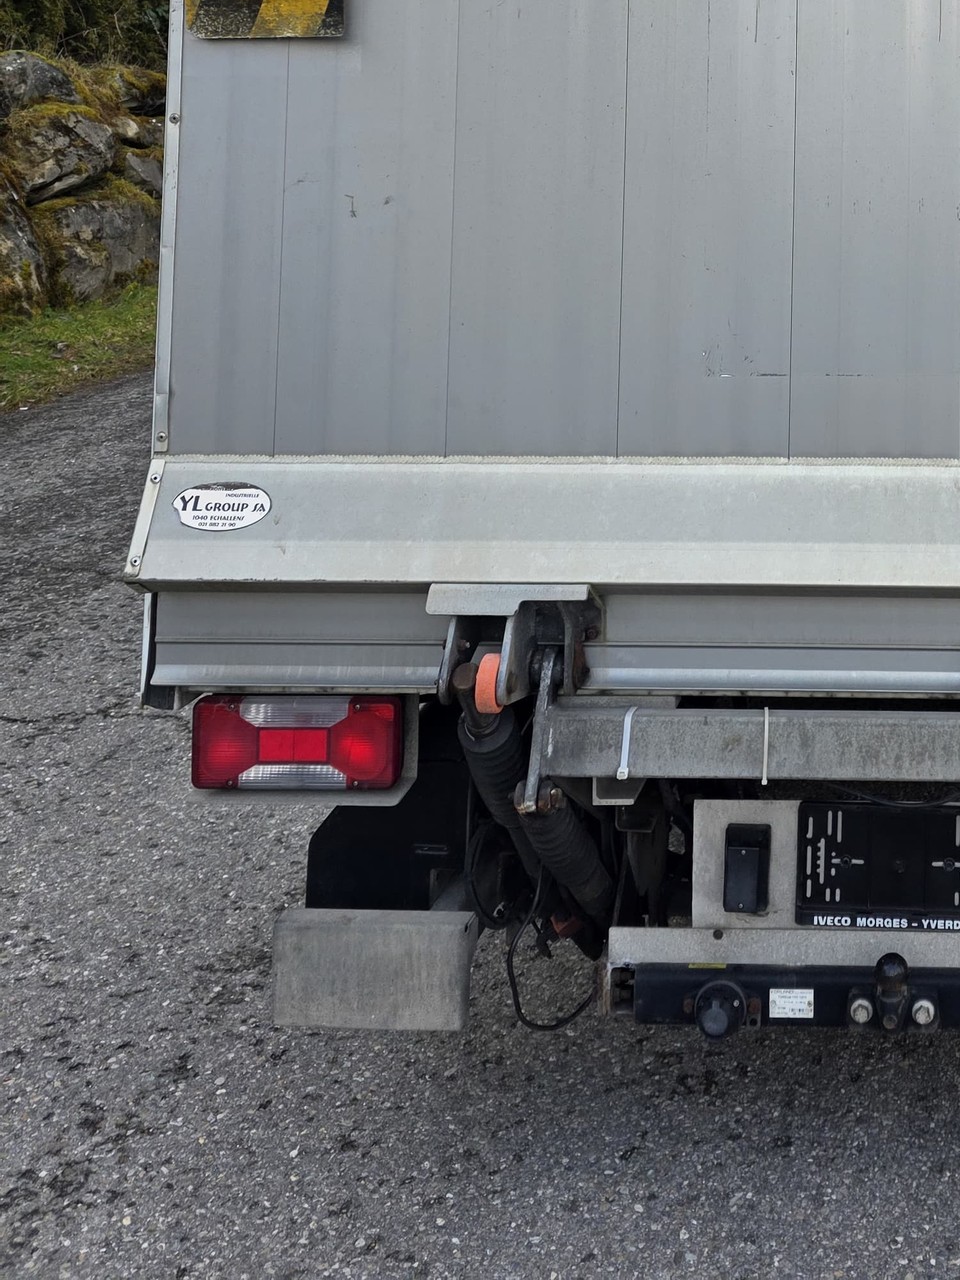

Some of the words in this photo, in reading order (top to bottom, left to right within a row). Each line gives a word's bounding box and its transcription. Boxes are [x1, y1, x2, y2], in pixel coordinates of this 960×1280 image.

[180, 495, 203, 512] YL
[205, 502, 249, 512] GROUP
[251, 503, 266, 513] SA
[813, 915, 851, 926] IVECO
[856, 917, 908, 929] MORGES
